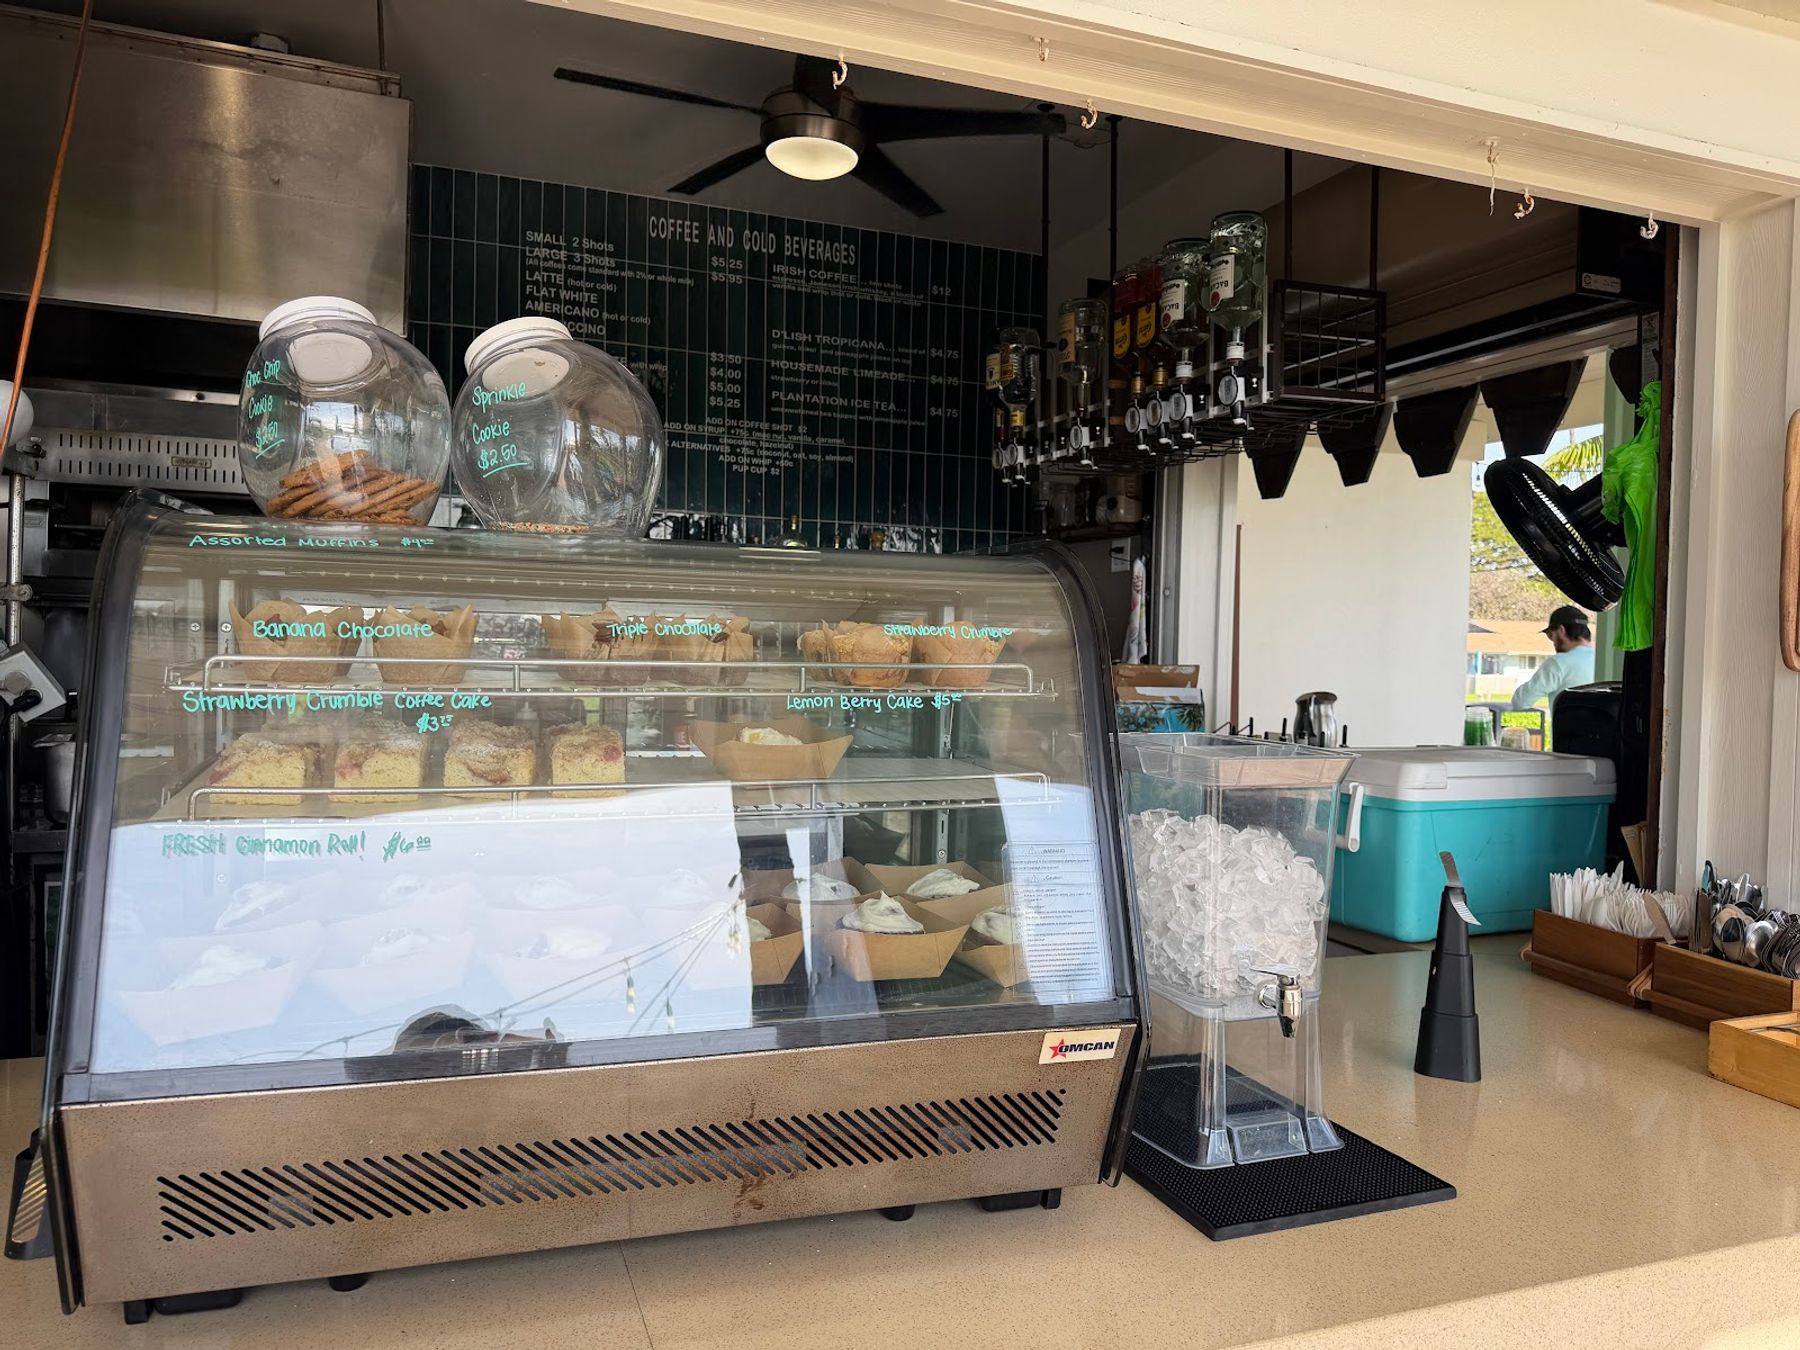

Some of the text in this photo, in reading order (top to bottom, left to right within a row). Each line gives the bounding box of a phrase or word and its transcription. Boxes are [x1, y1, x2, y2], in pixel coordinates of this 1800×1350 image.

[526, 230, 615, 253] SMALL 2 Shots
[649, 215, 856, 266] COFFEE AND COLD BEVERAGES
[526, 246, 616, 268] LARGE 3 Shots
[711, 256, 744, 270] $5.25
[711, 271, 743, 285] $5.95
[773, 264, 806, 277] IRISH
[526, 271, 564, 284] LATTE
[596, 281, 617, 293] cold)
[526, 285, 598, 304] FLAT WHITE
[932, 285, 952, 297] $12
[525, 299, 600, 319] AMERICANO
[772, 329, 812, 343] D'LISH
[930, 347, 959, 360] $4.75
[709, 366, 742, 380] $4.00
[771, 360, 849, 376] HOUSEMADE
[709, 381, 741, 394] $5.00
[472, 382, 527, 413] Sprinkle
[709, 396, 741, 409] $5.25
[772, 390, 848, 407] PLANTATION
[850, 396, 870, 409] ICE
[248, 394, 273, 419] Cookie
[930, 406, 959, 418] $4.75
[472, 418, 510, 445] Cookie
[663, 422, 682, 430] ADD
[683, 423, 697, 431] ON
[705, 416, 808, 434] ADD ON COFFEE SHOT $2
[670, 440, 731, 454] ALTERNATIVES
[477, 443, 517, 470] $2.50
[718, 454, 737, 463] ADD
[738, 456, 750, 465] ON
[752, 458, 772, 466] WHIP
[732, 464, 749, 473] PUP
[750, 466, 768, 474] CUP
[188, 534, 286, 548] Assorted
[252, 620, 434, 639] Banana Chocolate
[606, 621, 723, 639] Triple Chocolate
[883, 623, 956, 639] Strawberry
[182, 690, 492, 715] Strawberry Crumble Coffee Cake
[786, 693, 834, 711] Lemon
[840, 696, 882, 713] Berry
[886, 693, 923, 711] Cake
[162, 832, 226, 858] FRESH
[235, 834, 321, 857] Cinnamon
[1058, 1040, 1115, 1053] OMCAN
